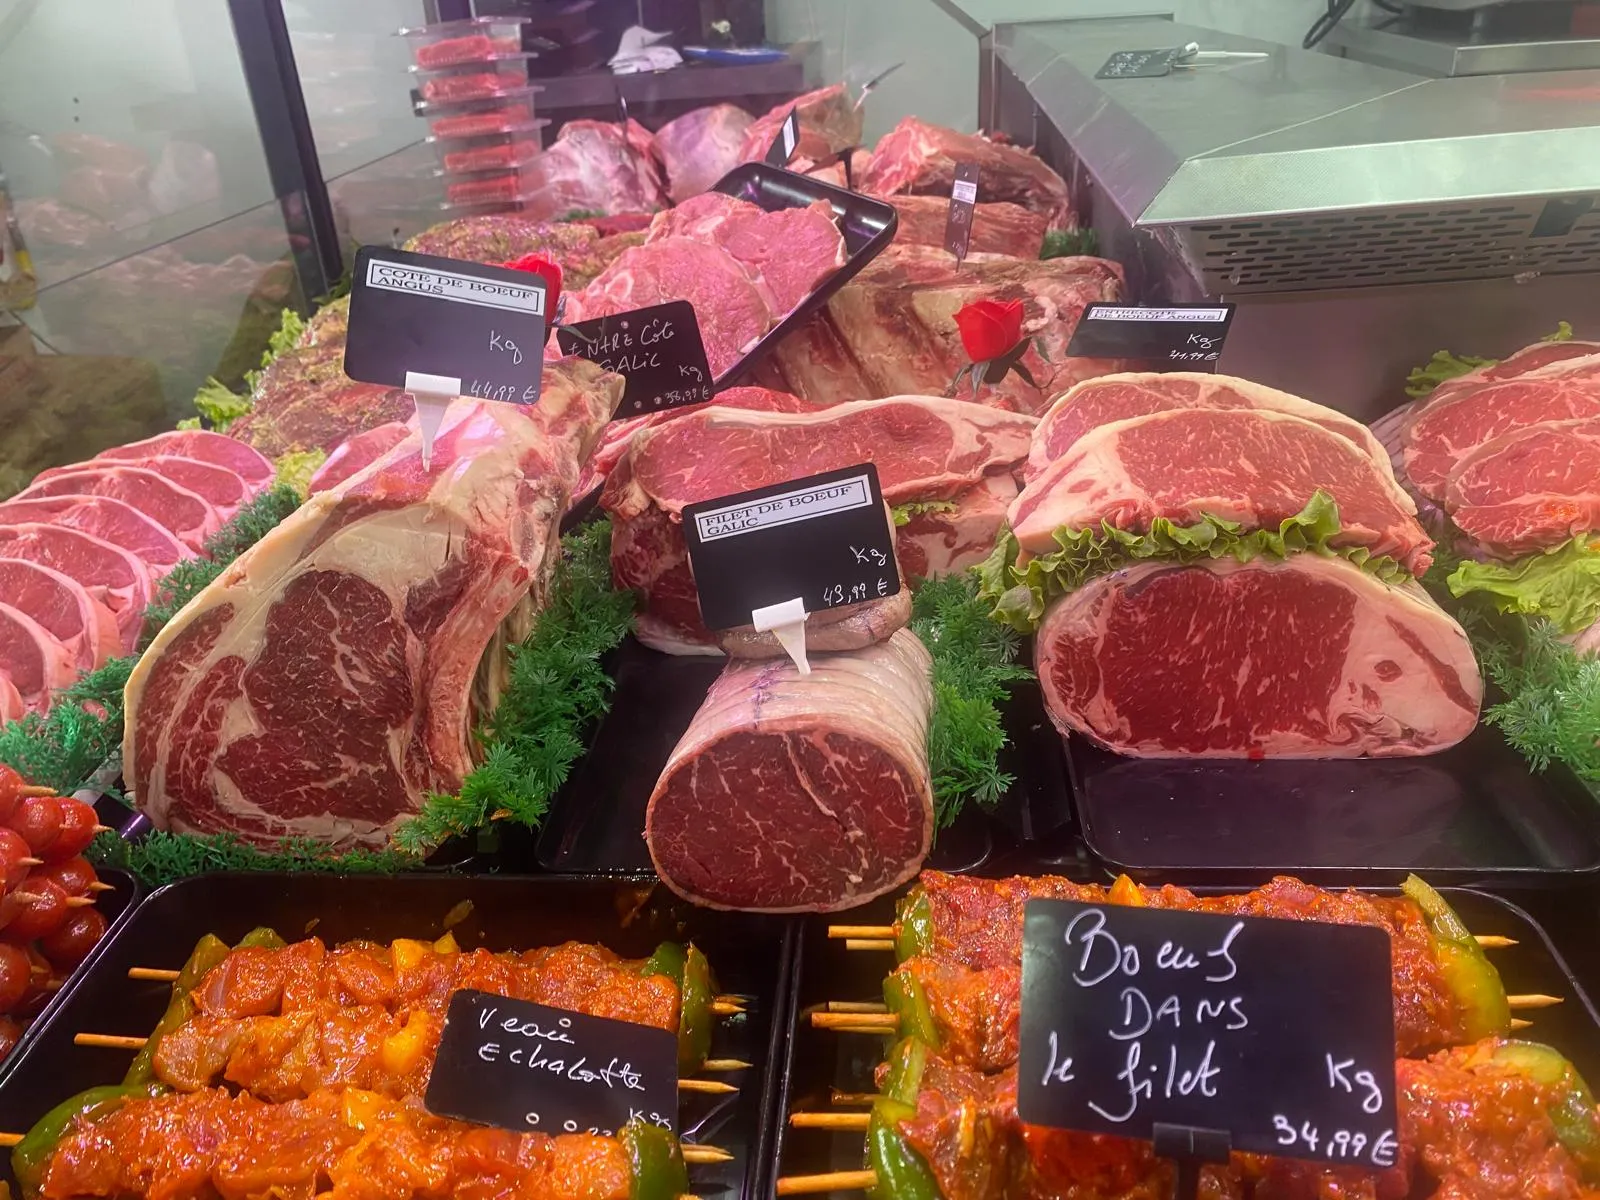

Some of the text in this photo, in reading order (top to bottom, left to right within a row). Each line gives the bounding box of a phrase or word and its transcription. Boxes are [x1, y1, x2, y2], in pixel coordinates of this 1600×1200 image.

[378, 267, 533, 300] COTE DE BOEUF
[378, 276, 443, 294] ANGUS
[1167, 313, 1217, 321] ANGUS
[489, 330, 523, 364] Kg
[1187, 333, 1222, 349] Kg
[1205, 352, 1219, 360] €
[679, 365, 703, 382] Kg
[470, 380, 536, 404] 44,99 €
[702, 384, 710, 400] €
[704, 486, 852, 527] FILET DE BOEUF
[707, 516, 759, 536] GALIC
[849, 545, 887, 566] Kg
[877, 577, 888, 596] €
[1109, 989, 1249, 1041] DANS
[1041, 1031, 1221, 1122] le filet
[1325, 1053, 1383, 1113] Kg
